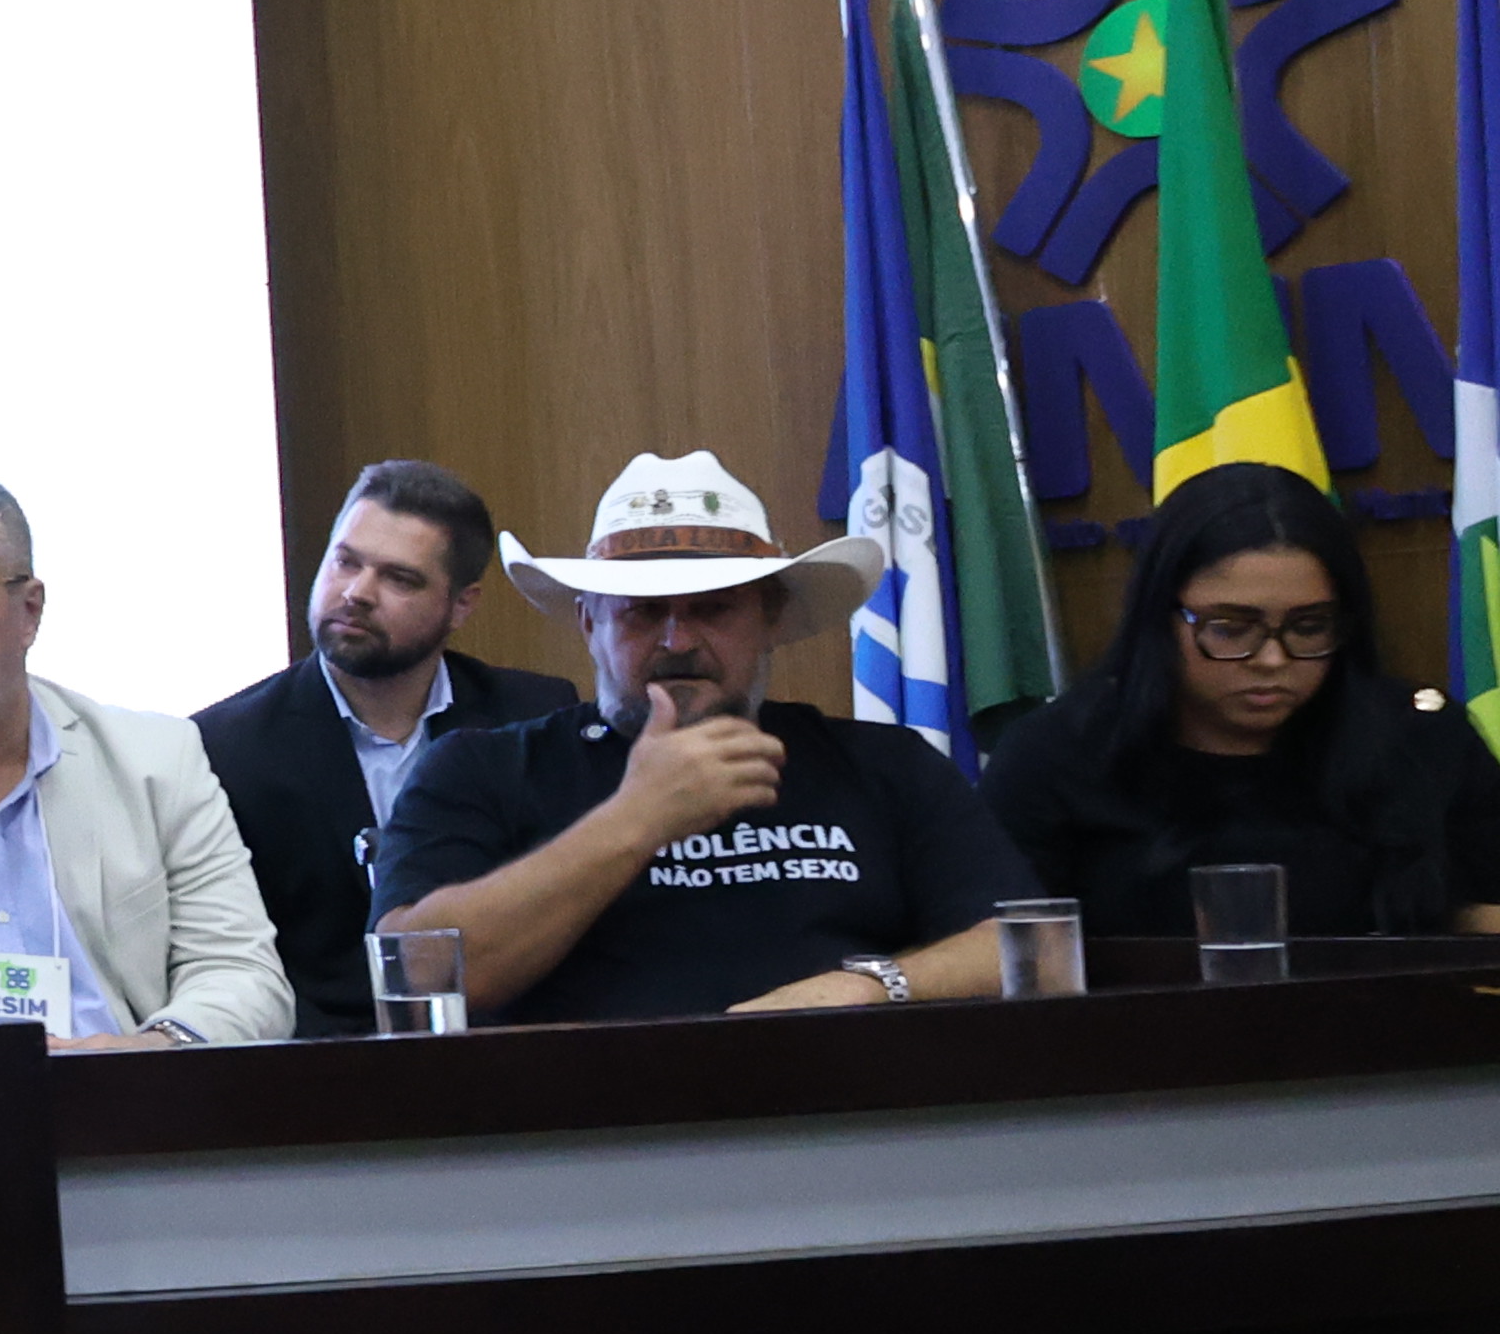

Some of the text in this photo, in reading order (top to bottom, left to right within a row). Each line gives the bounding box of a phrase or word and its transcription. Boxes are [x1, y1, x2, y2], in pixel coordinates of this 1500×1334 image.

[649, 857, 860, 888] NÃO TEM SEXO
